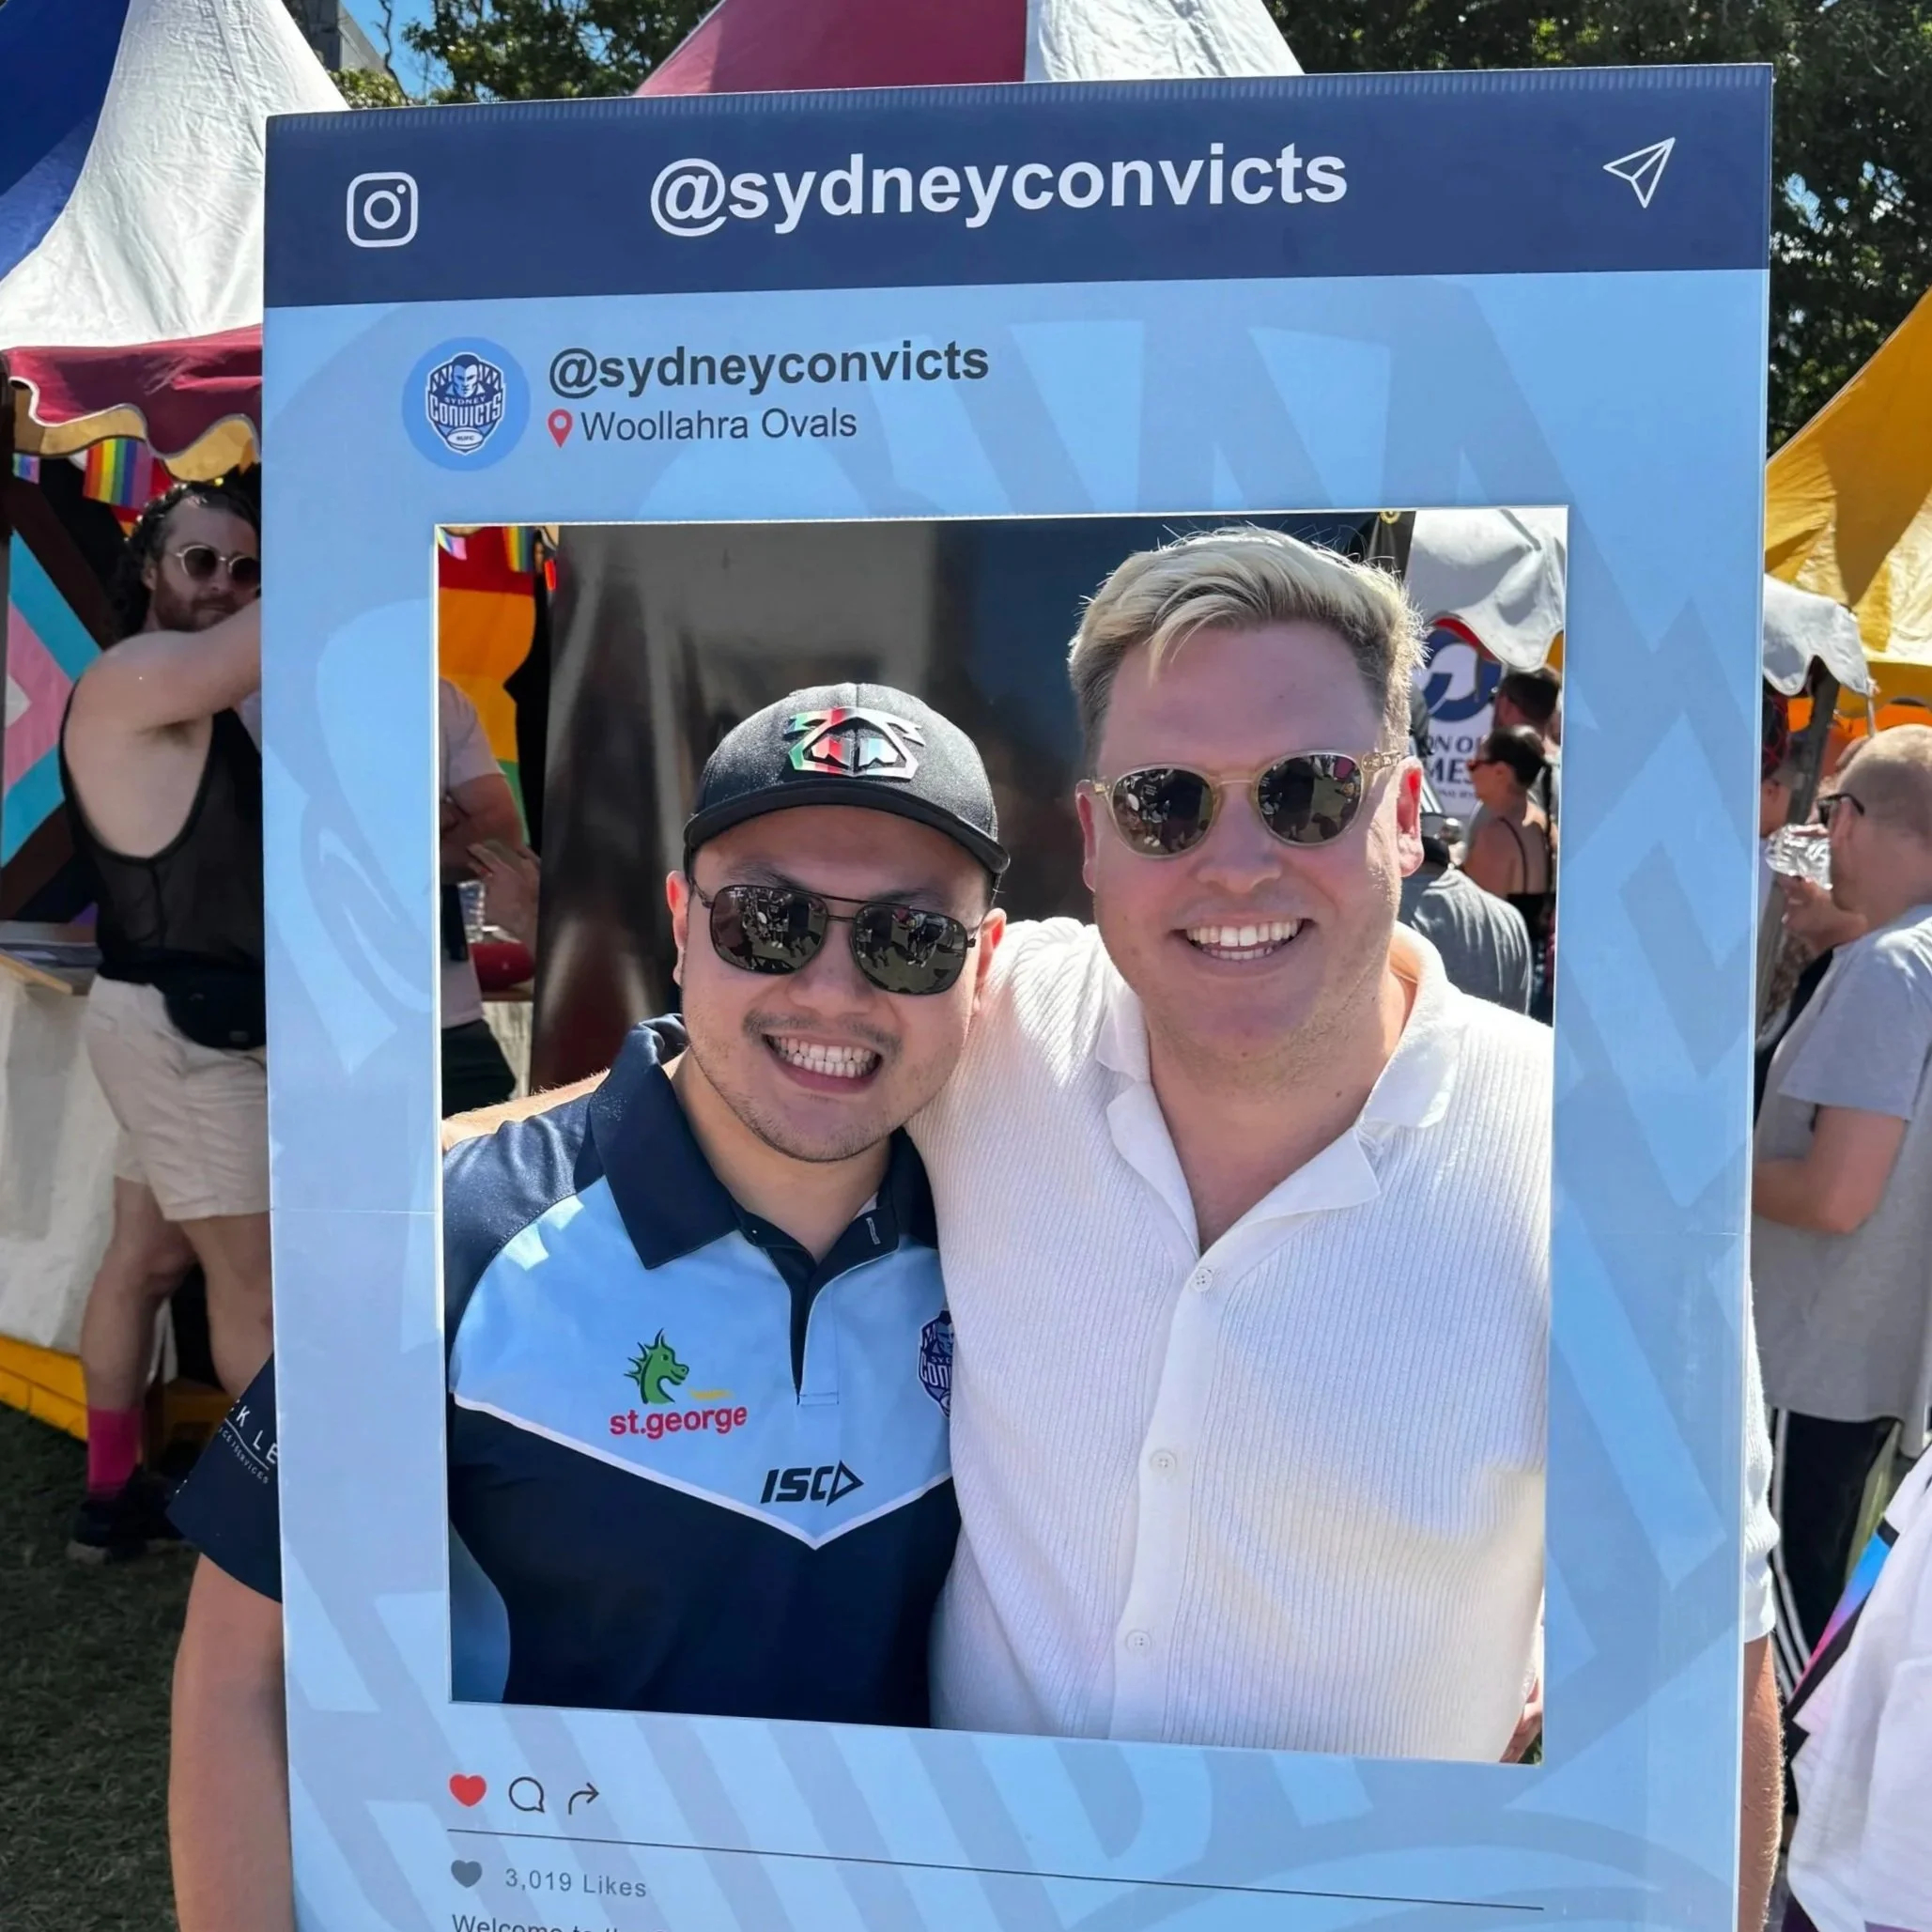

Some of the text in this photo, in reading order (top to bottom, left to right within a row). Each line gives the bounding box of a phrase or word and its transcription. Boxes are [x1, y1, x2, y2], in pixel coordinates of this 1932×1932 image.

[650, 143, 1347, 238] @sydneyconvicts
[549, 340, 989, 399] @sydneyconvicts
[429, 392, 502, 426] CONVICTS
[443, 394, 487, 405] SYDNEY
[580, 407, 857, 440] Woollahra Ovals
[921, 1350, 951, 1388] CON
[610, 1406, 748, 1440] st.george
[504, 1867, 647, 1898] 3,019 Likes
